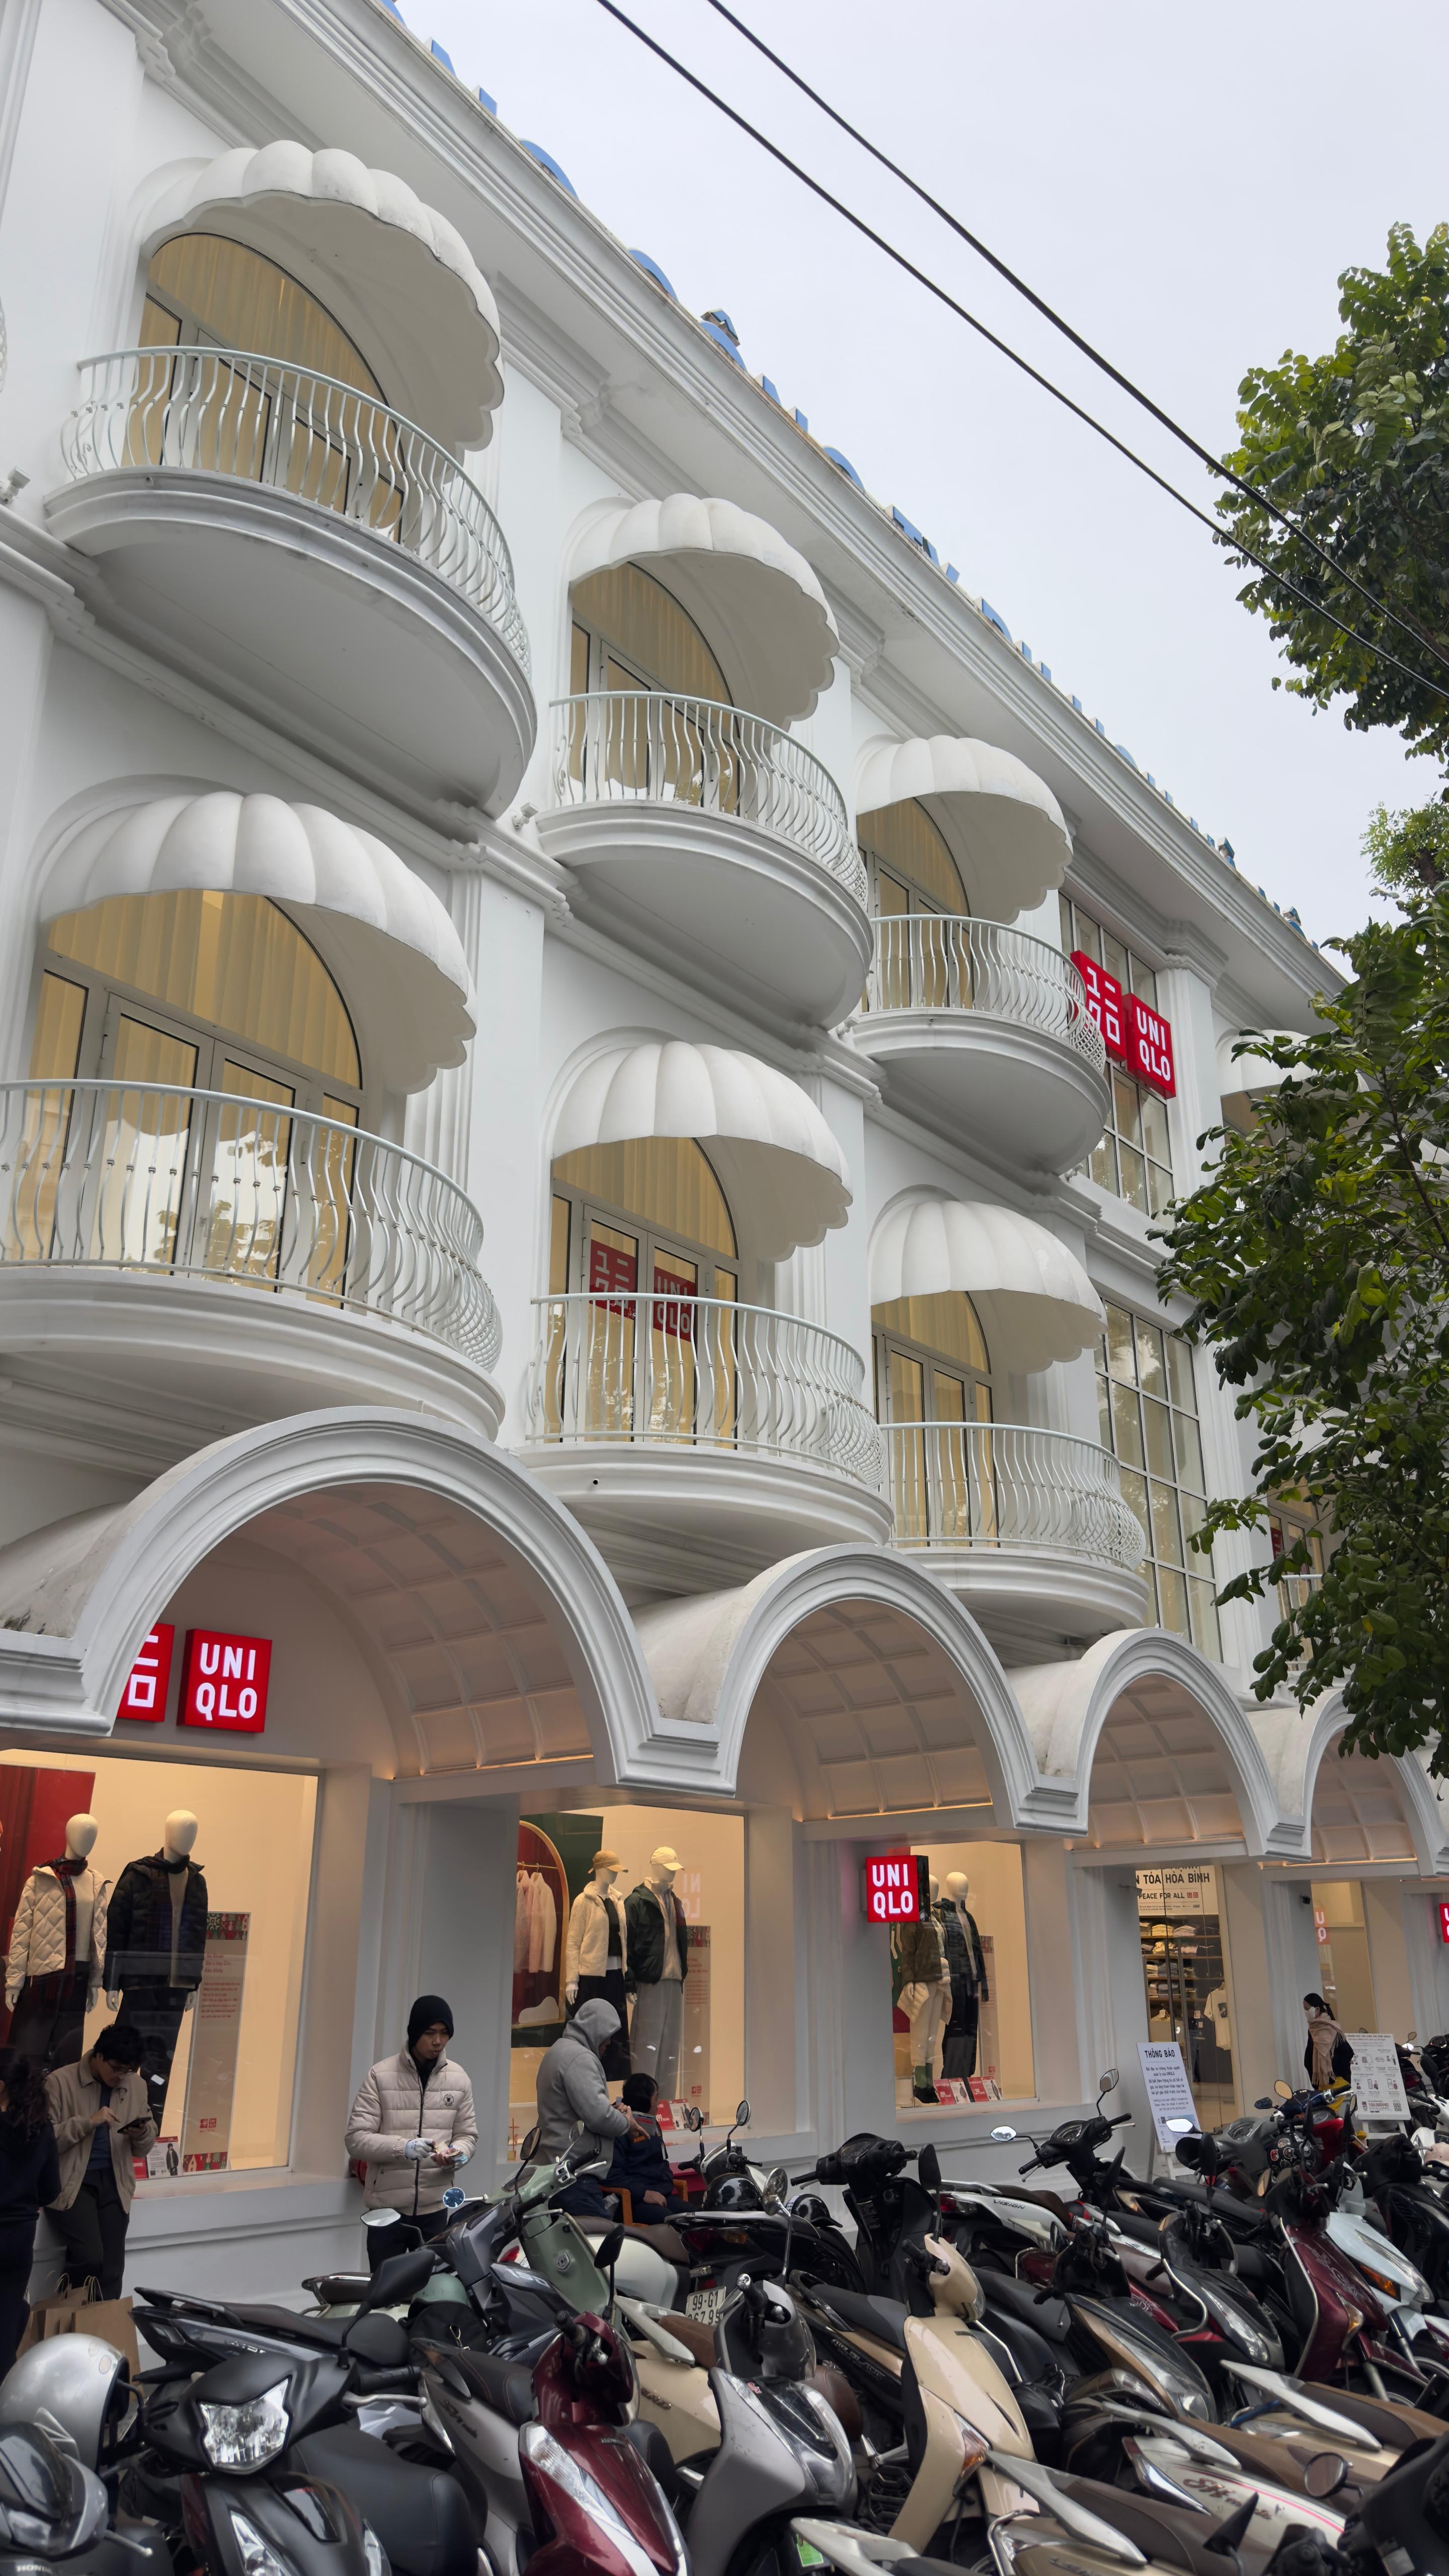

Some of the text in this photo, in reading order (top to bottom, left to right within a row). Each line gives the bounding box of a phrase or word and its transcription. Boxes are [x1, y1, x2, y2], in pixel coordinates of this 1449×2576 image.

[1136, 1006, 1166, 1051] UNI
[1139, 1039, 1171, 1081] QLO
[658, 1276, 688, 1308] UNI
[200, 1643, 256, 1680] UNI
[196, 1682, 257, 1721] QLO
[872, 1864, 908, 1887] UNI
[1143, 1871, 1161, 1884] TỎA
[1165, 1871, 1184, 1884] HÒA
[1188, 1870, 1210, 1883] BÌNH
[873, 1891, 913, 1918] QLO
[1145, 2047, 1175, 2058] THÔNG BÁO
[994, 2199, 1025, 2209] VISION
[692, 2291, 718, 2311] 99-G1
